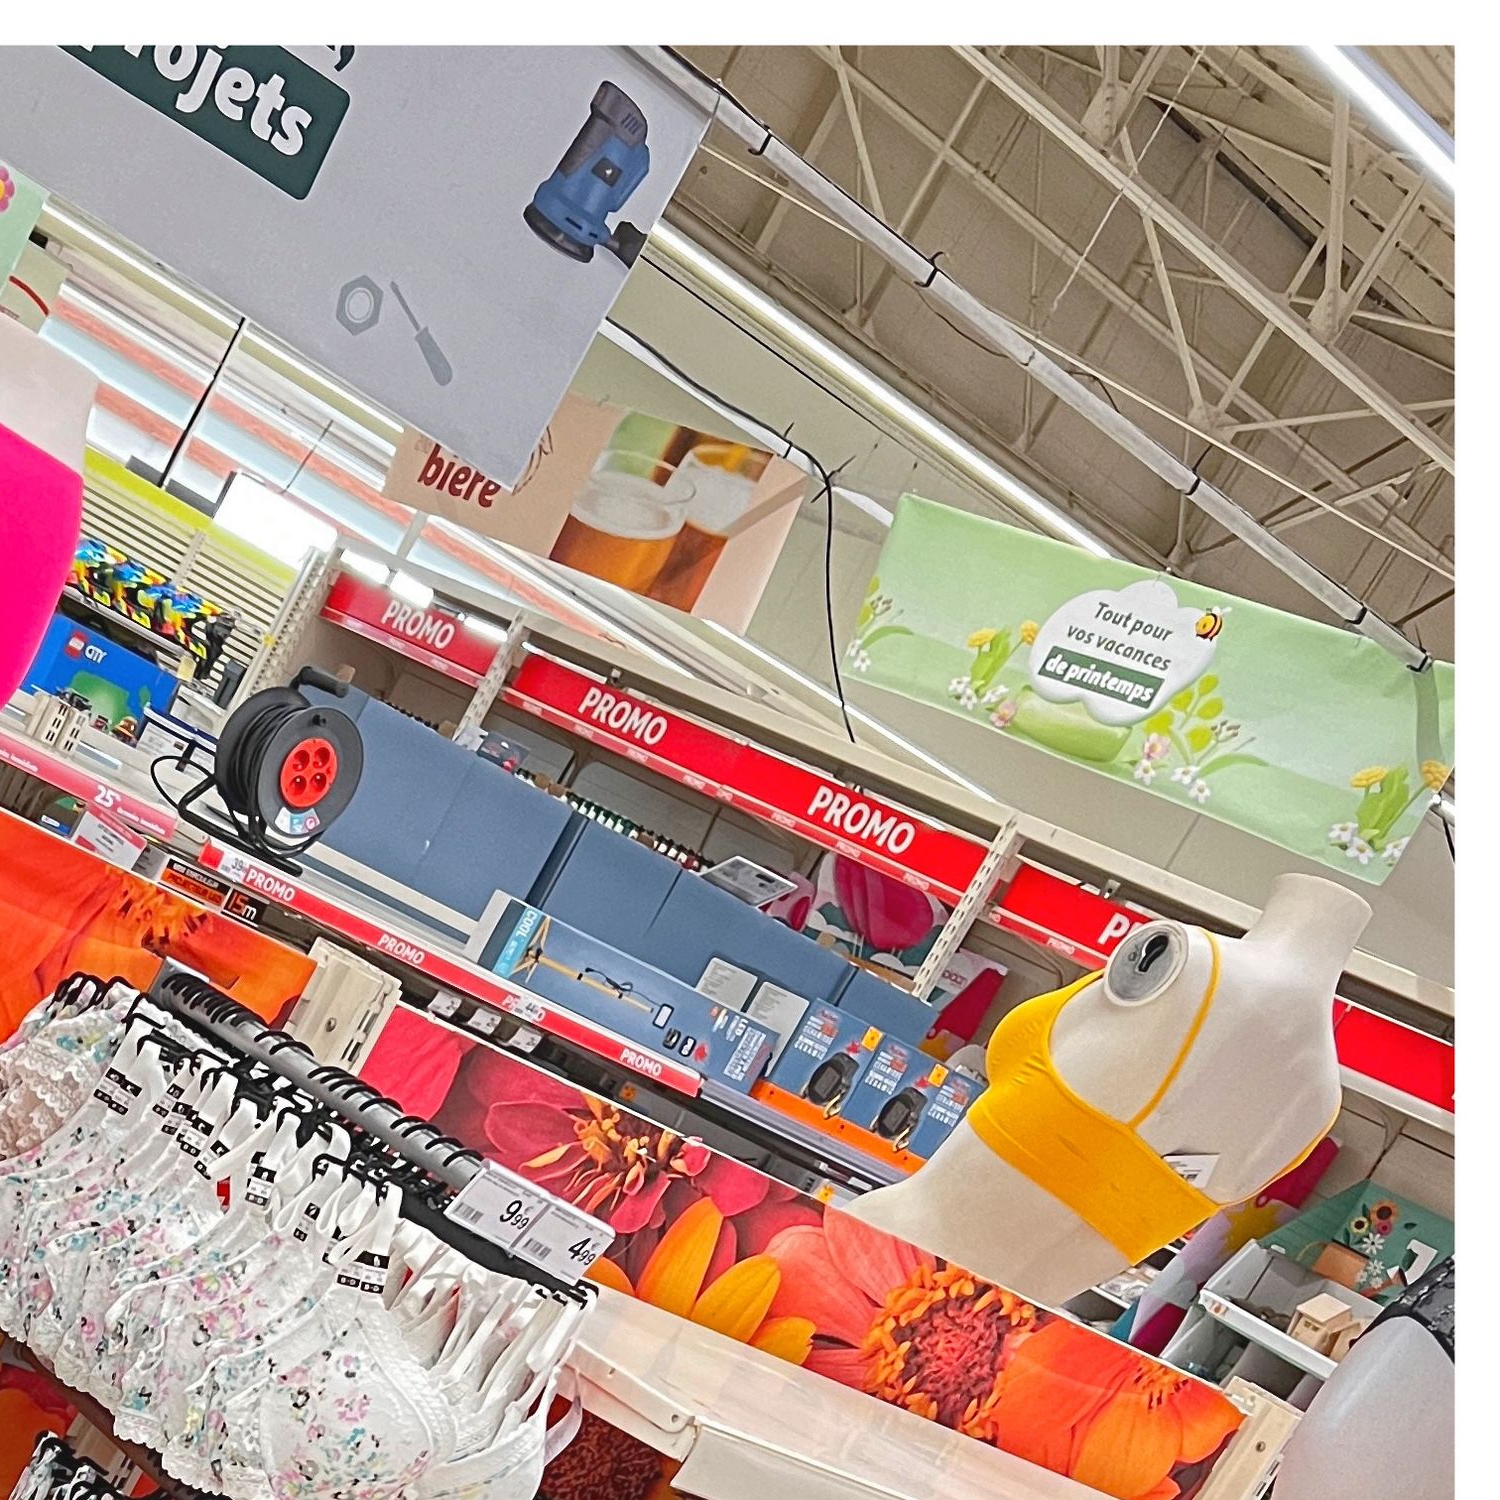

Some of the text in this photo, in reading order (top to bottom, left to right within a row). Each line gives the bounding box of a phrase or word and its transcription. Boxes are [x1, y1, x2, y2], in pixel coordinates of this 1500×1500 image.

[78, 45, 313, 156] ojets
[380, 599, 456, 650] PROMO
[1093, 601, 1174, 642] Tout pour
[1067, 624, 1172, 672] vos vacances
[1044, 654, 1154, 703] de printemps
[577, 686, 668, 746] PROMO
[806, 785, 915, 855] PROMO
[245, 868, 296, 902] PROMO
[516, 909, 537, 938] COOL
[377, 933, 426, 966] PROMO
[619, 1047, 664, 1079] PROMO
